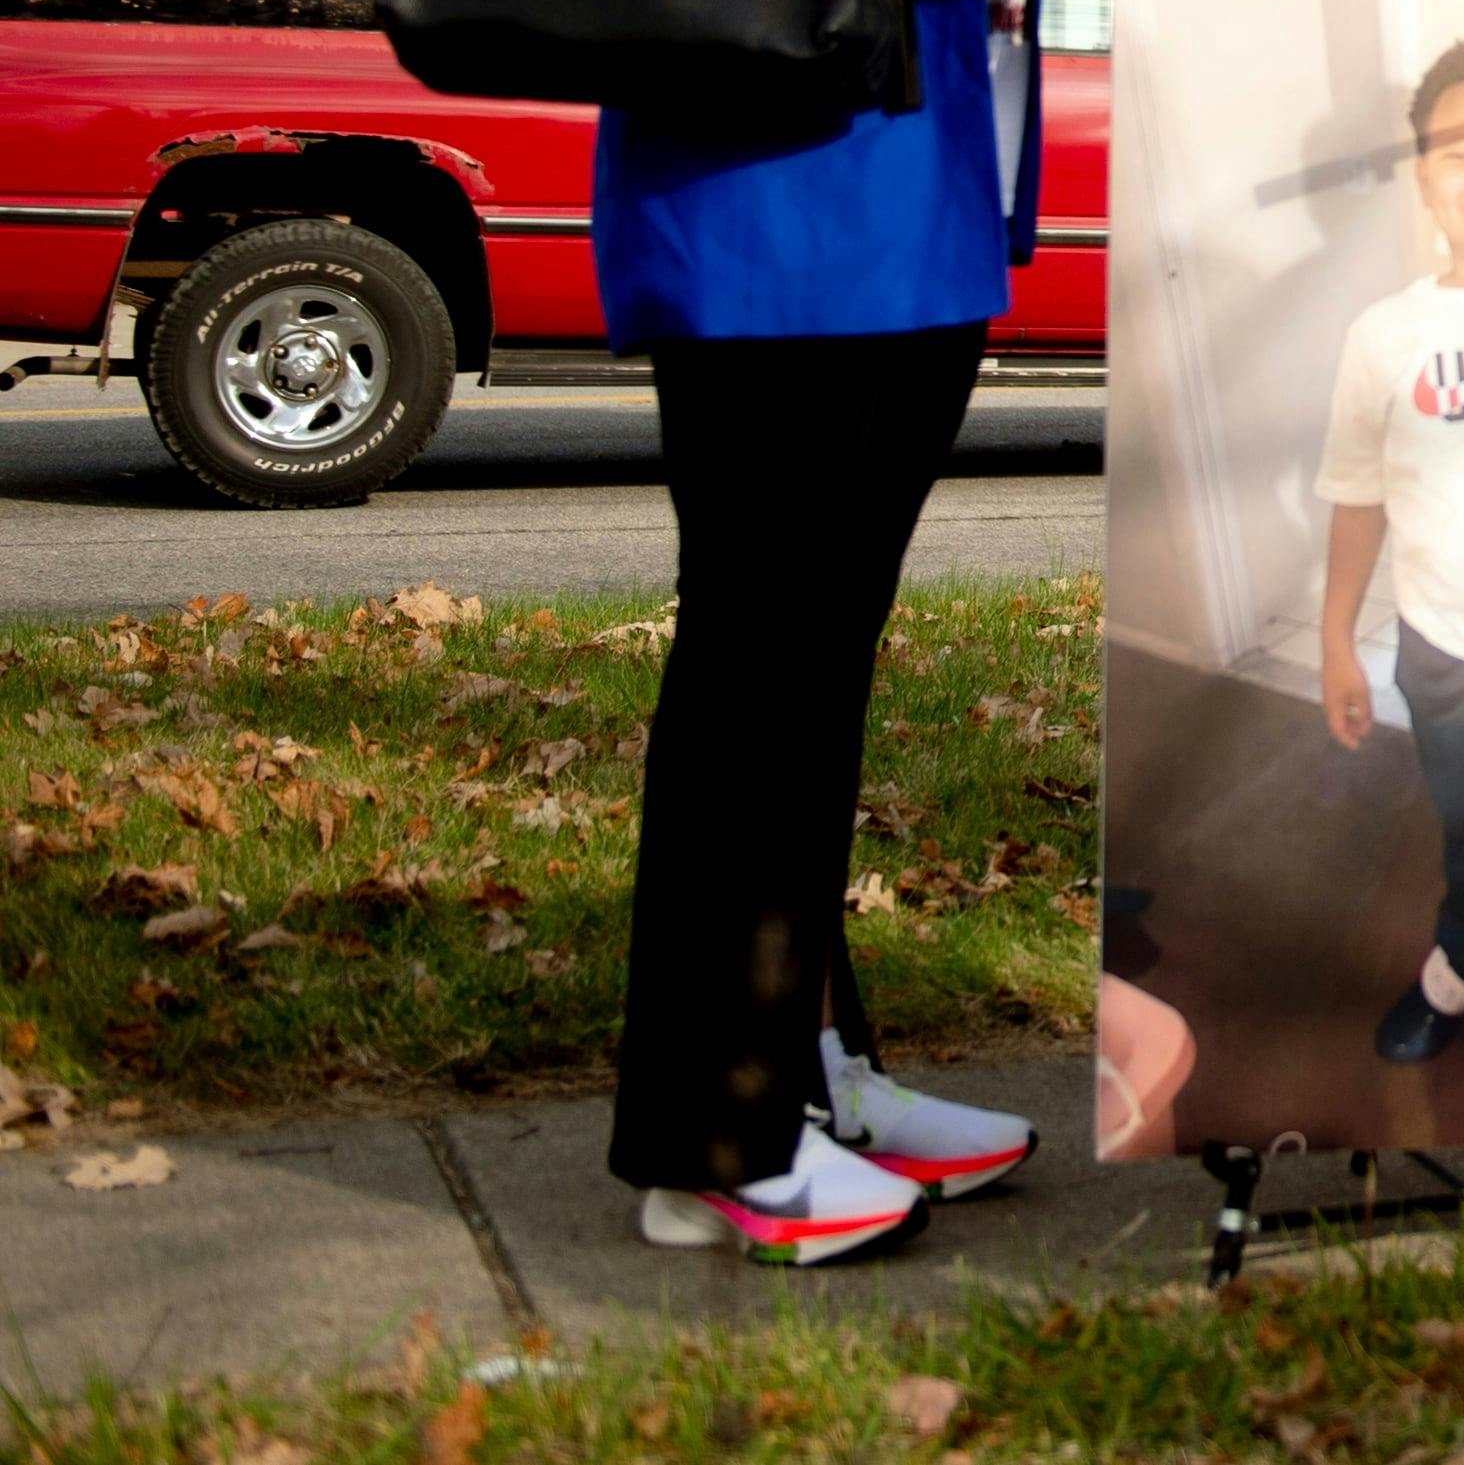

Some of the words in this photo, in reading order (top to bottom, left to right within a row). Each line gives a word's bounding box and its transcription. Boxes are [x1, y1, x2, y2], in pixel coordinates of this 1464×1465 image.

[196, 261, 320, 345] All-Terrain
[324, 262, 364, 284] T/A
[254, 400, 406, 475] BFGoodrich
